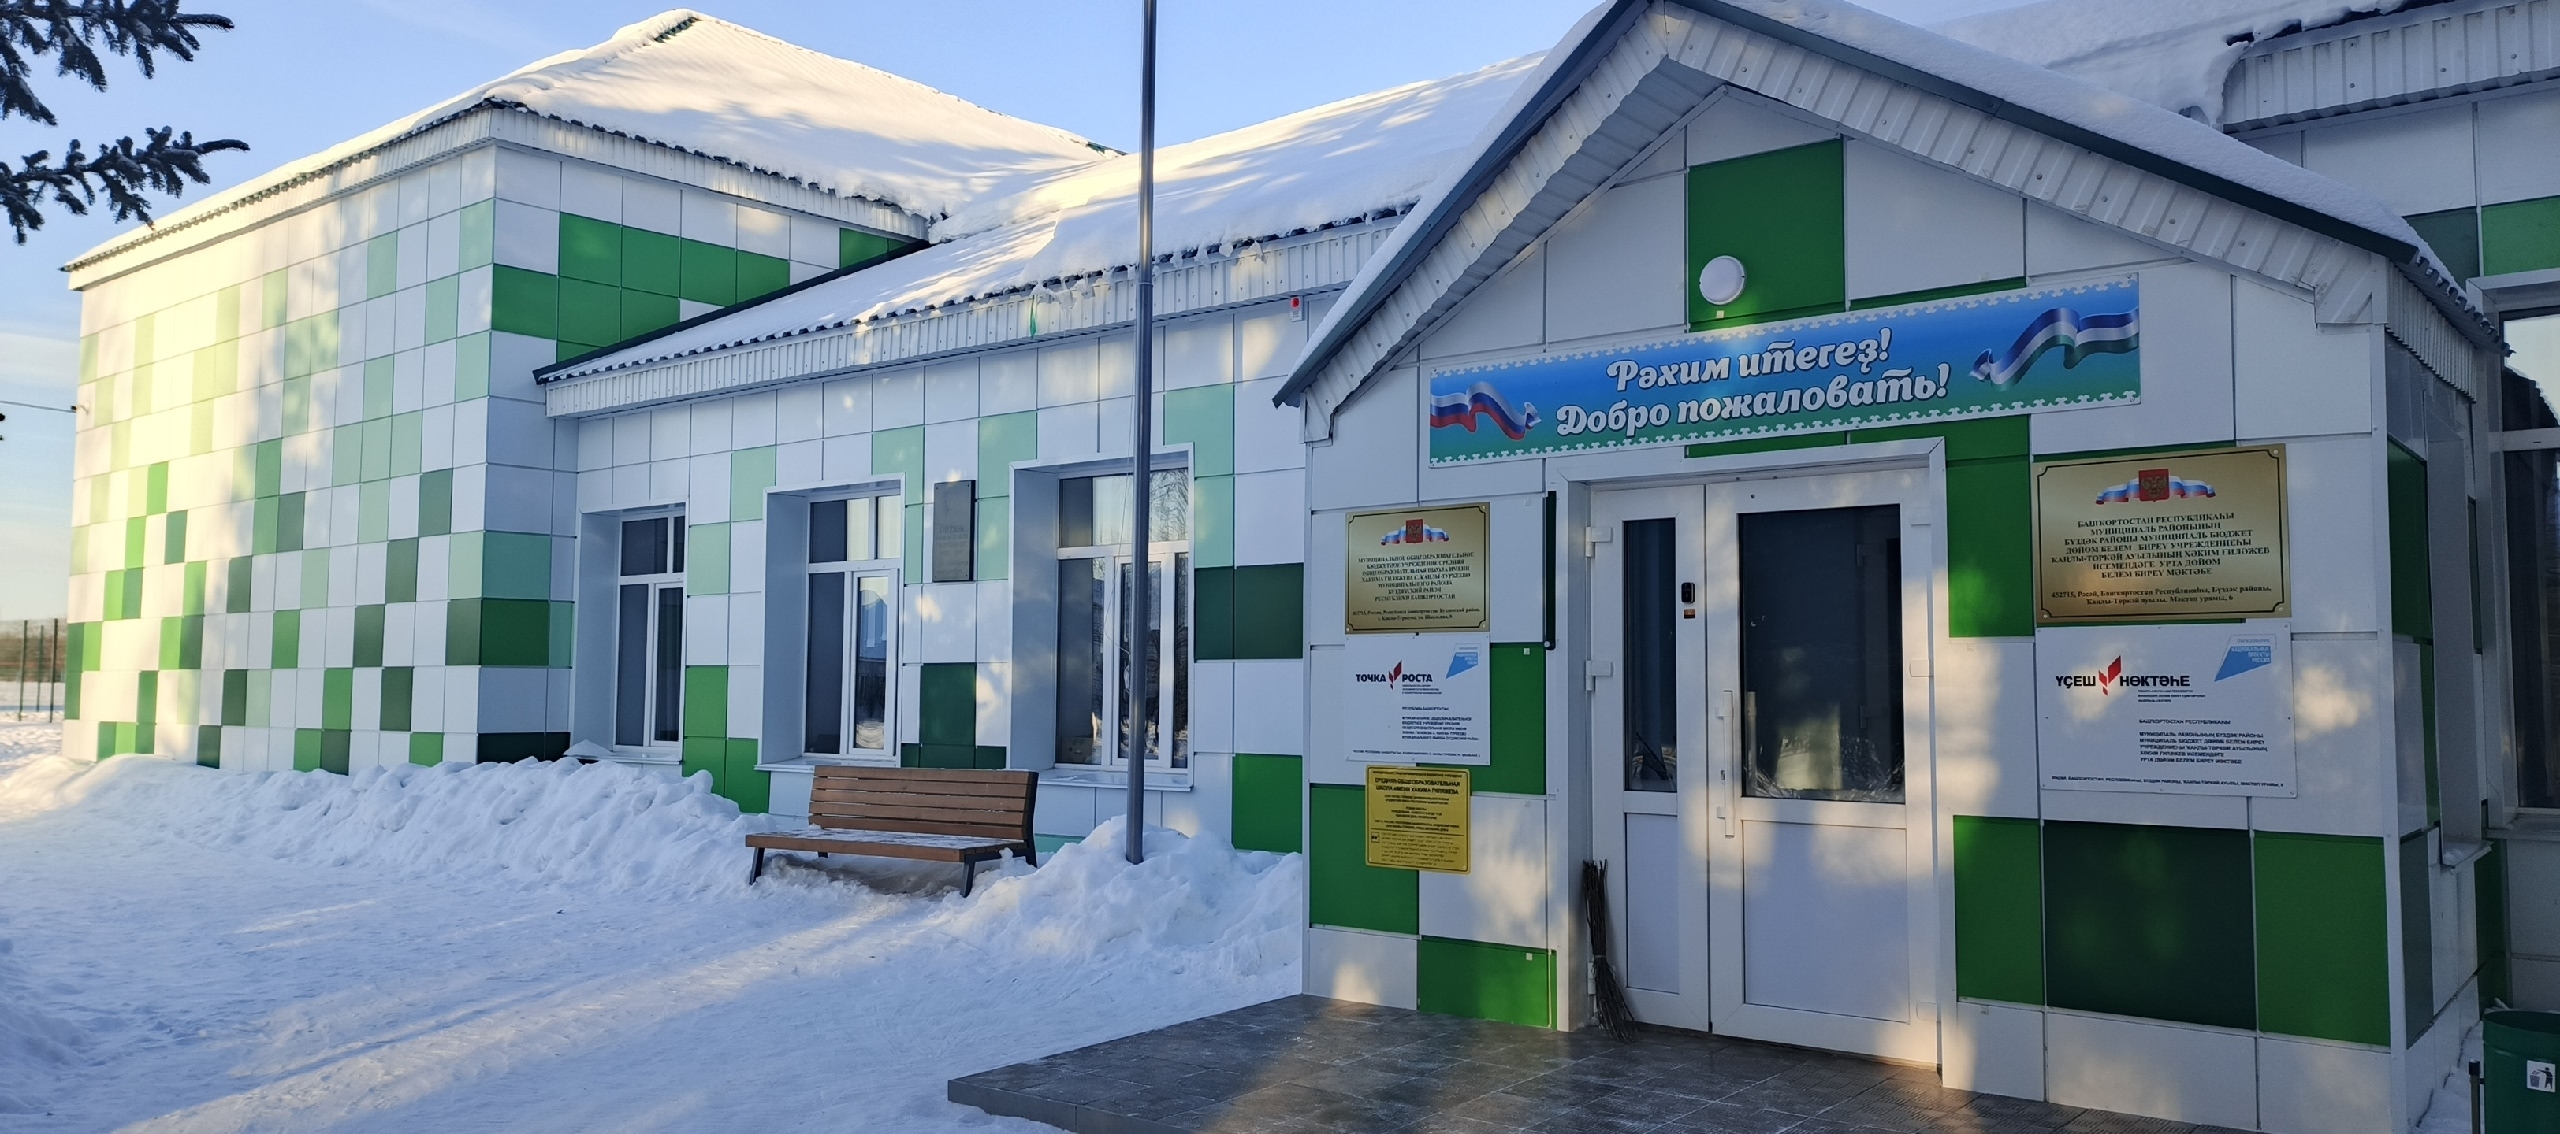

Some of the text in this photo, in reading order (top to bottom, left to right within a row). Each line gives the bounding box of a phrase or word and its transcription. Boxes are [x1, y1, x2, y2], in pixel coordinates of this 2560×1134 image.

[1607, 355, 1730, 391] Рәхим
[1556, 362, 1952, 437] Добро пожаловать!
[2091, 525, 2157, 536] МУНИЦИПАЛЬ
[2099, 535, 2138, 544] РАЙОНЫ
[2139, 531, 2208, 542] МУНИЦИПАЛЬ
[2209, 529, 2254, 539] БЮДЖЕТ
[2101, 545, 2133, 553] БЕЛЕМ
[2159, 560, 2183, 568] УРТА
[2101, 570, 2133, 579] БЕЛЕМ
[1355, 673, 1433, 682] ТОЧКА РОСТА
[2119, 675, 2191, 687] НӨКТӘҺЕ
